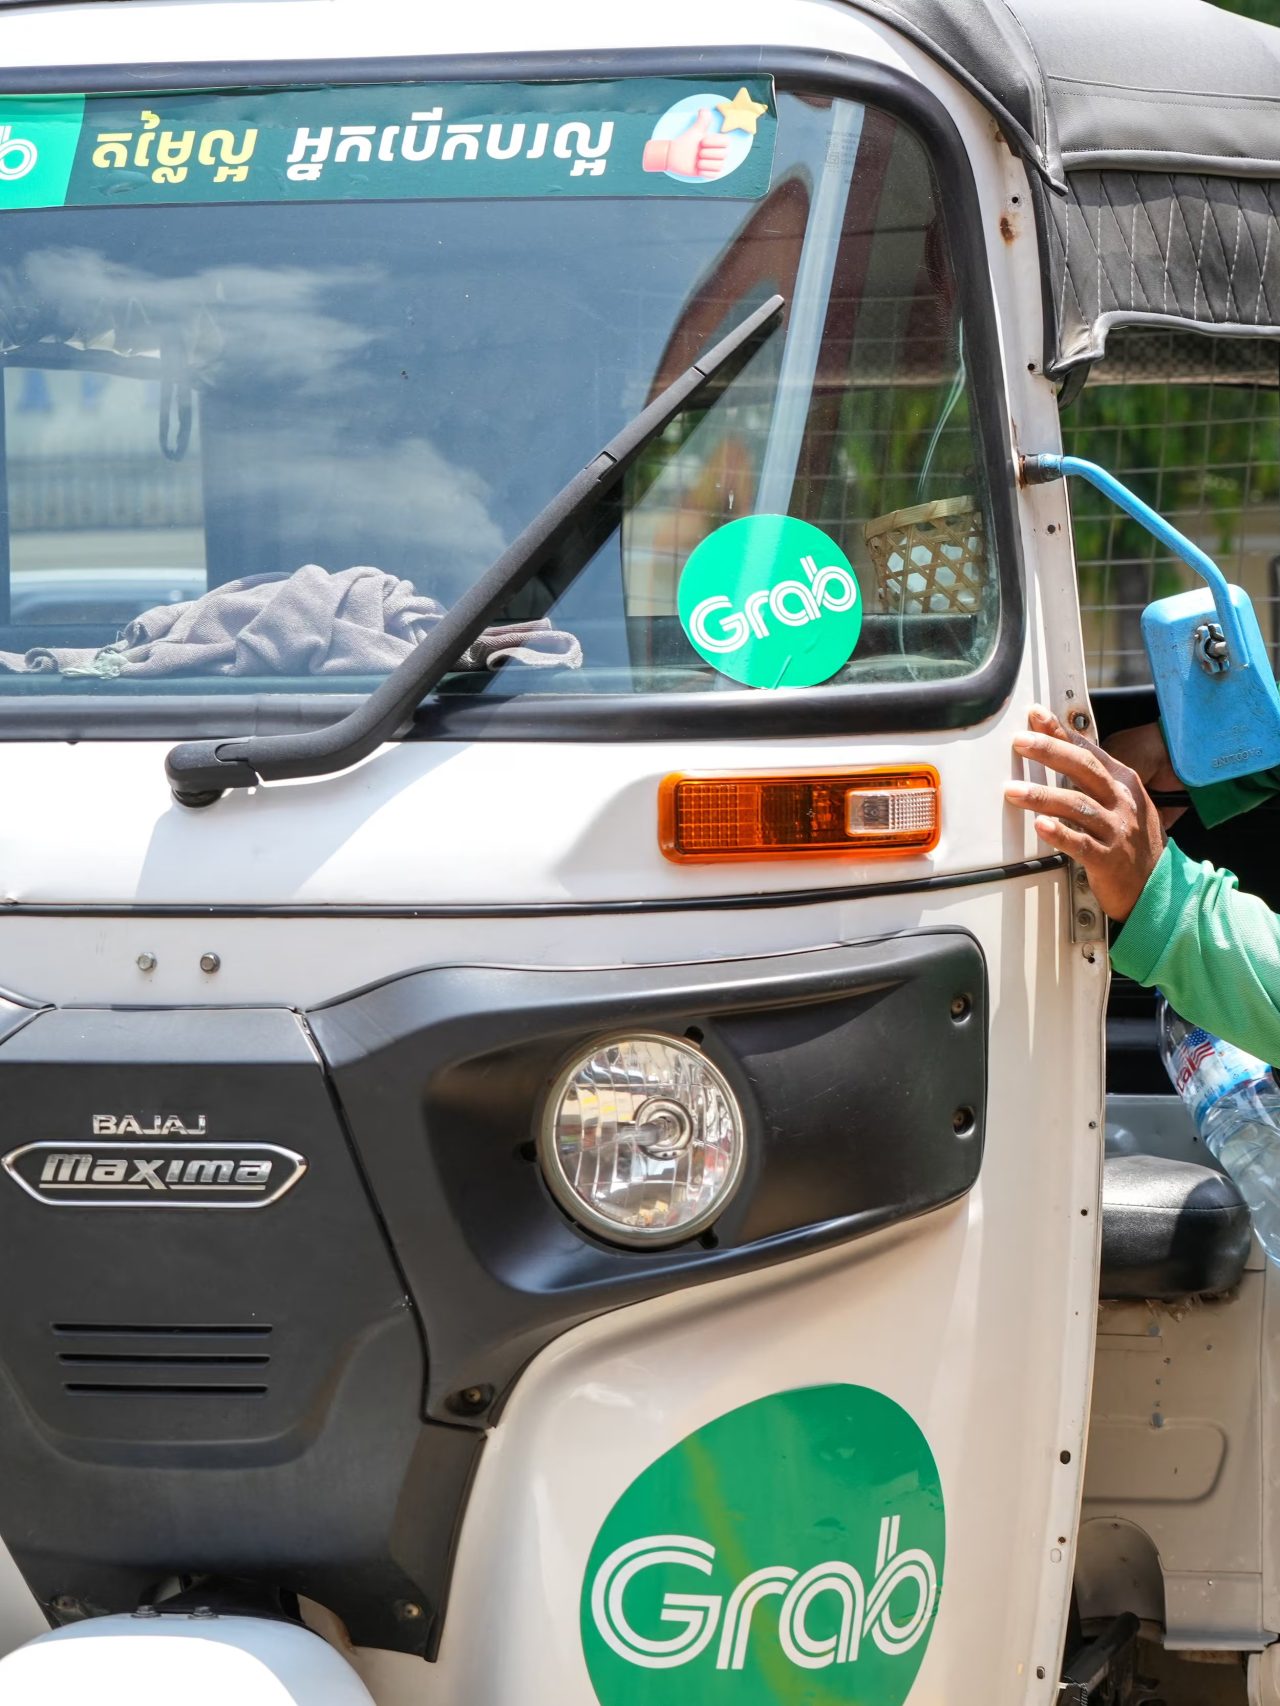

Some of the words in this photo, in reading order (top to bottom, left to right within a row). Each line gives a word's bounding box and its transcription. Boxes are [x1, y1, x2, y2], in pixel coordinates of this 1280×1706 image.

[689, 555, 857, 654] Grab
[92, 1114, 207, 1135] BAJAJ
[590, 1514, 937, 1671] Grab
